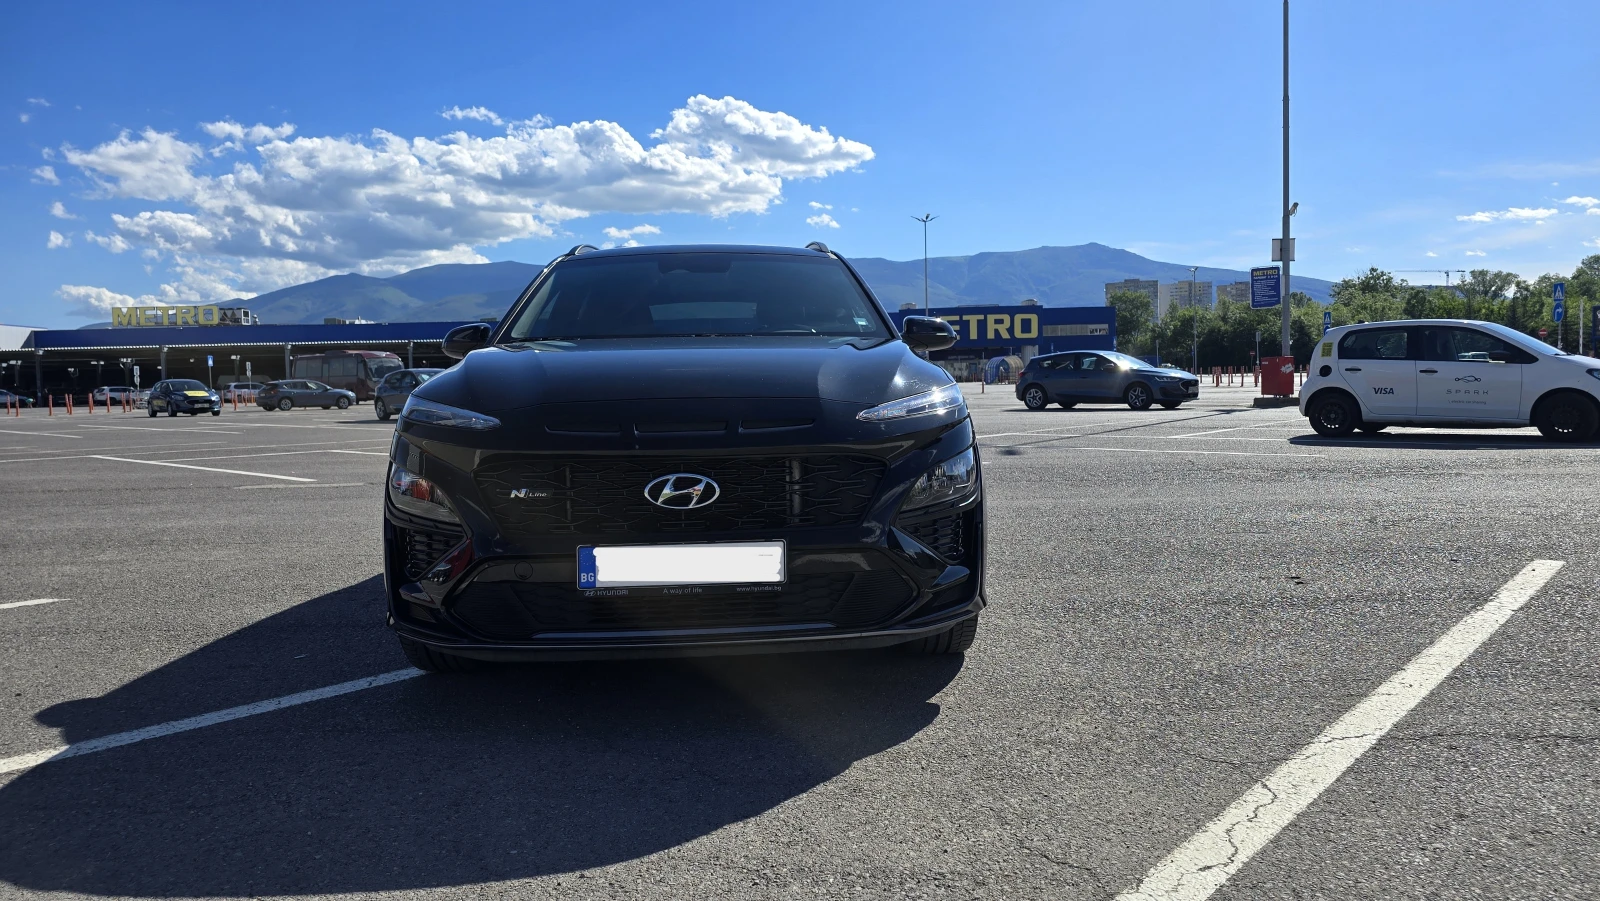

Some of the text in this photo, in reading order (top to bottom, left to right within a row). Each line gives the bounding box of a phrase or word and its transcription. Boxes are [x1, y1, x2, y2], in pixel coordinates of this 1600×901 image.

[1253, 269, 1278, 277] METRO
[112, 306, 219, 326] METRO
[940, 313, 1039, 339] TRO
[1372, 387, 1395, 395] VISA
[510, 488, 529, 498] N
[580, 573, 595, 582] BG
[736, 585, 782, 593] www.hyundai.bg
